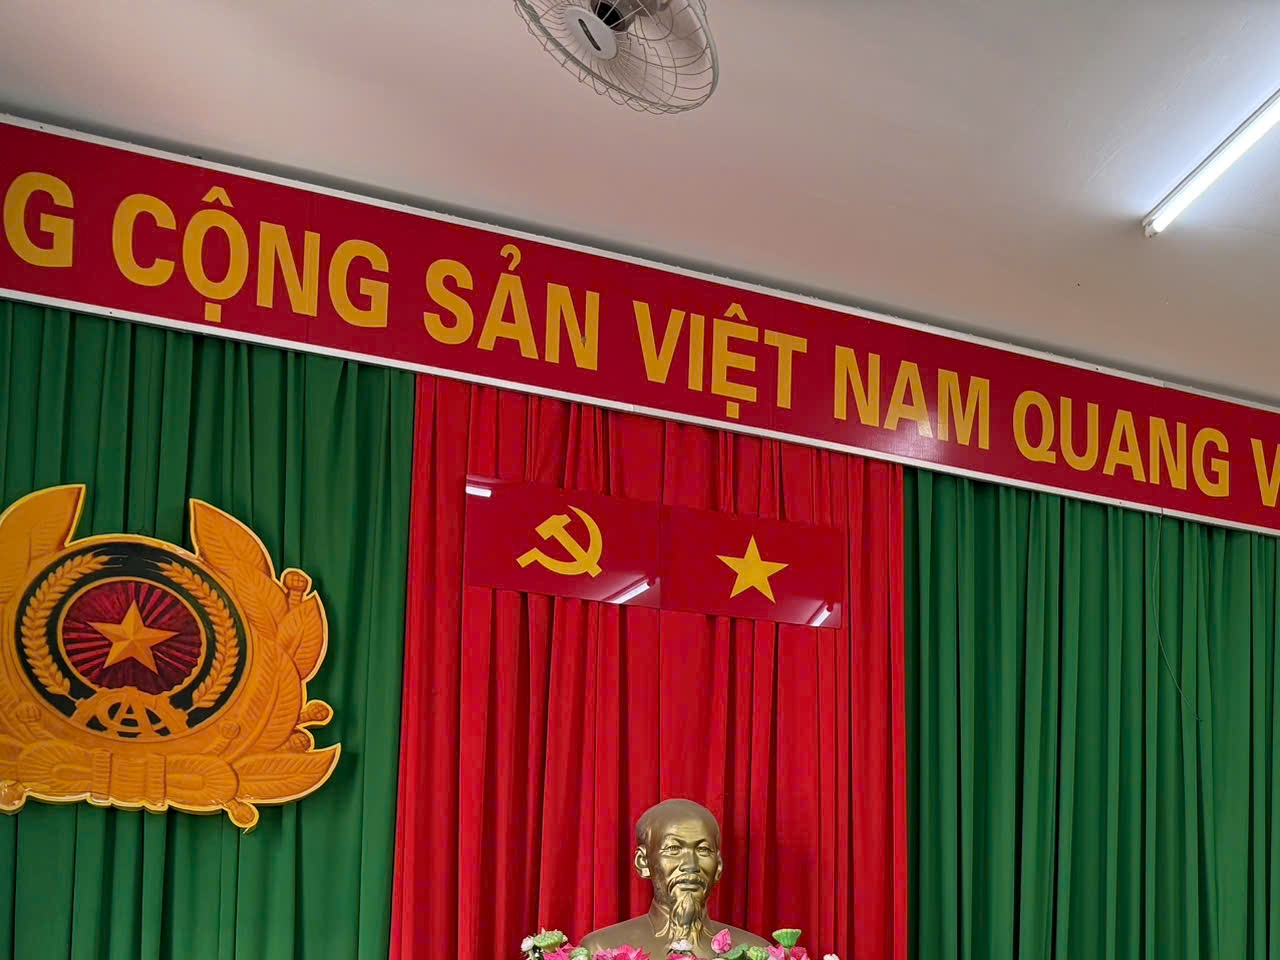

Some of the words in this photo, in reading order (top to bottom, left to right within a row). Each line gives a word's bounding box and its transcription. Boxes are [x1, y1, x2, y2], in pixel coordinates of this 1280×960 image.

[112, 186, 389, 328] CỘNG
[423, 244, 600, 371] SẢN
[633, 300, 808, 419] VIỆT
[833, 346, 991, 450] NAM
[1013, 391, 1230, 497] QUANG
